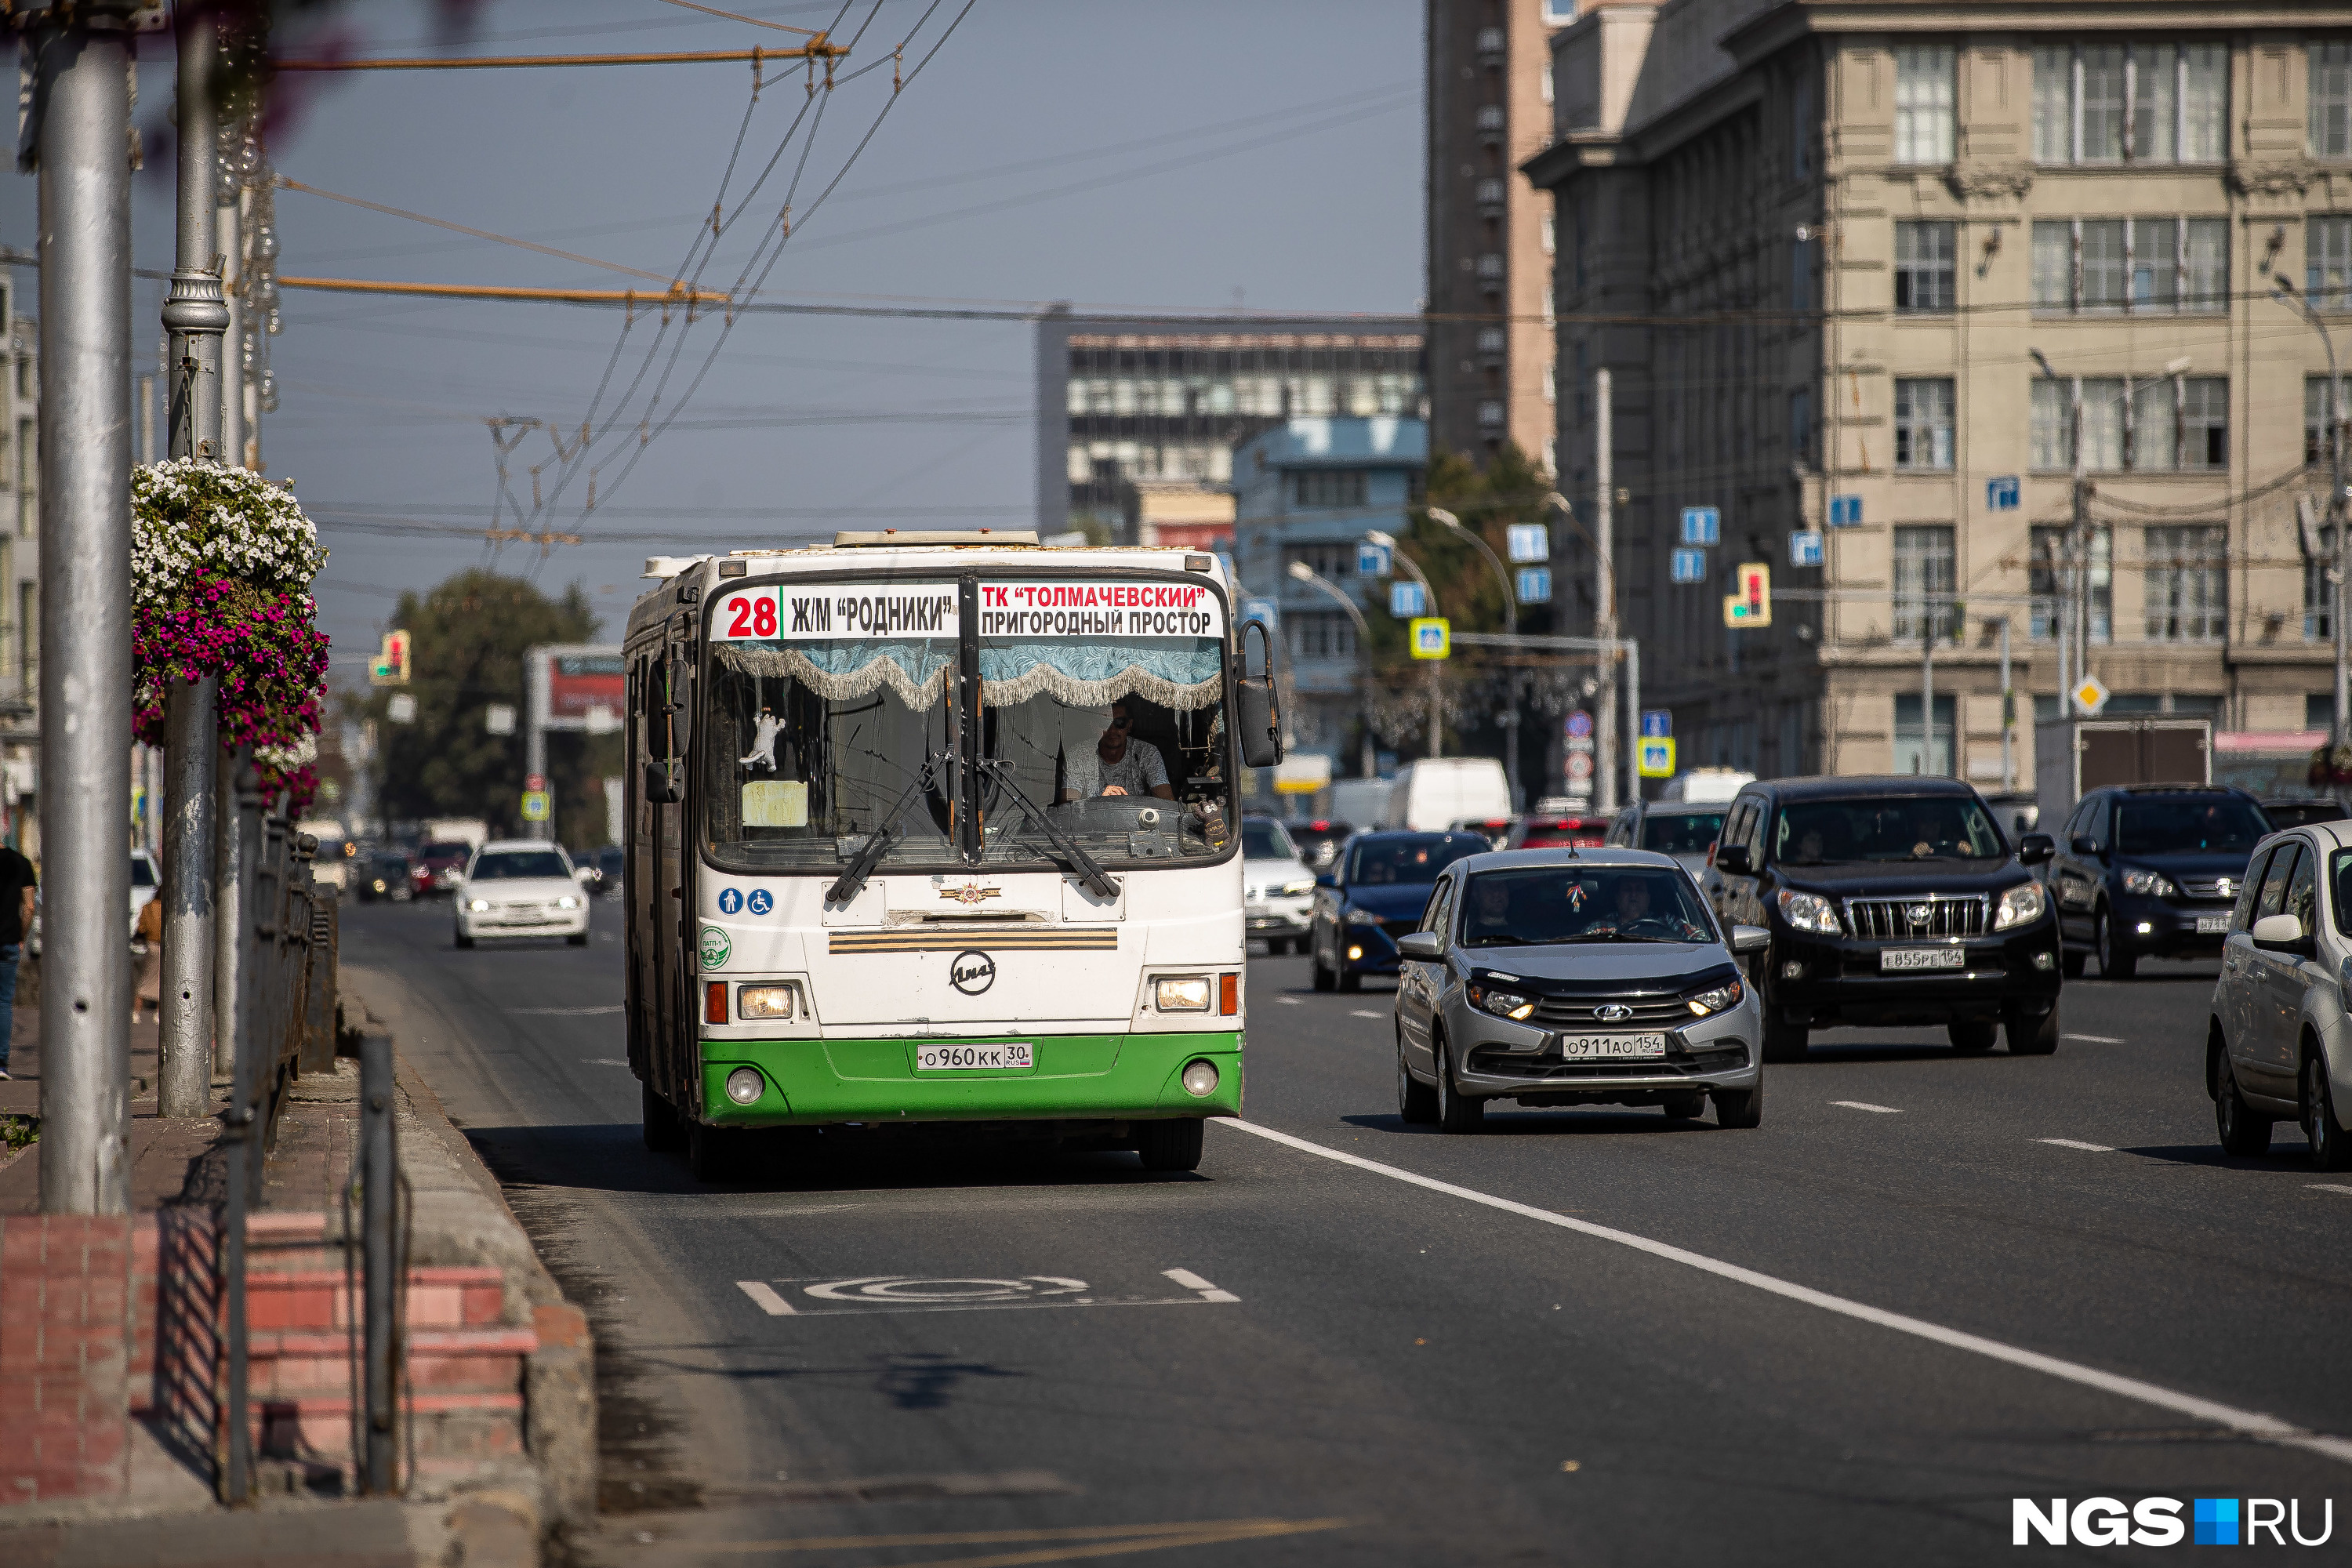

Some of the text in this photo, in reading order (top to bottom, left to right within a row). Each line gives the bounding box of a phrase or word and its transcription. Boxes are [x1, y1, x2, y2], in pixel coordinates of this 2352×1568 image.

[982, 586, 1009, 608] ТК
[728, 597, 777, 637] 28
[791, 597, 831, 633] Ж/М
[982, 609, 1210, 636] ПРИГОРОДНЫЙ ПРОСТОР
[1007, 1046, 1025, 1060] 30
[1635, 1036, 1661, 1050] 154
